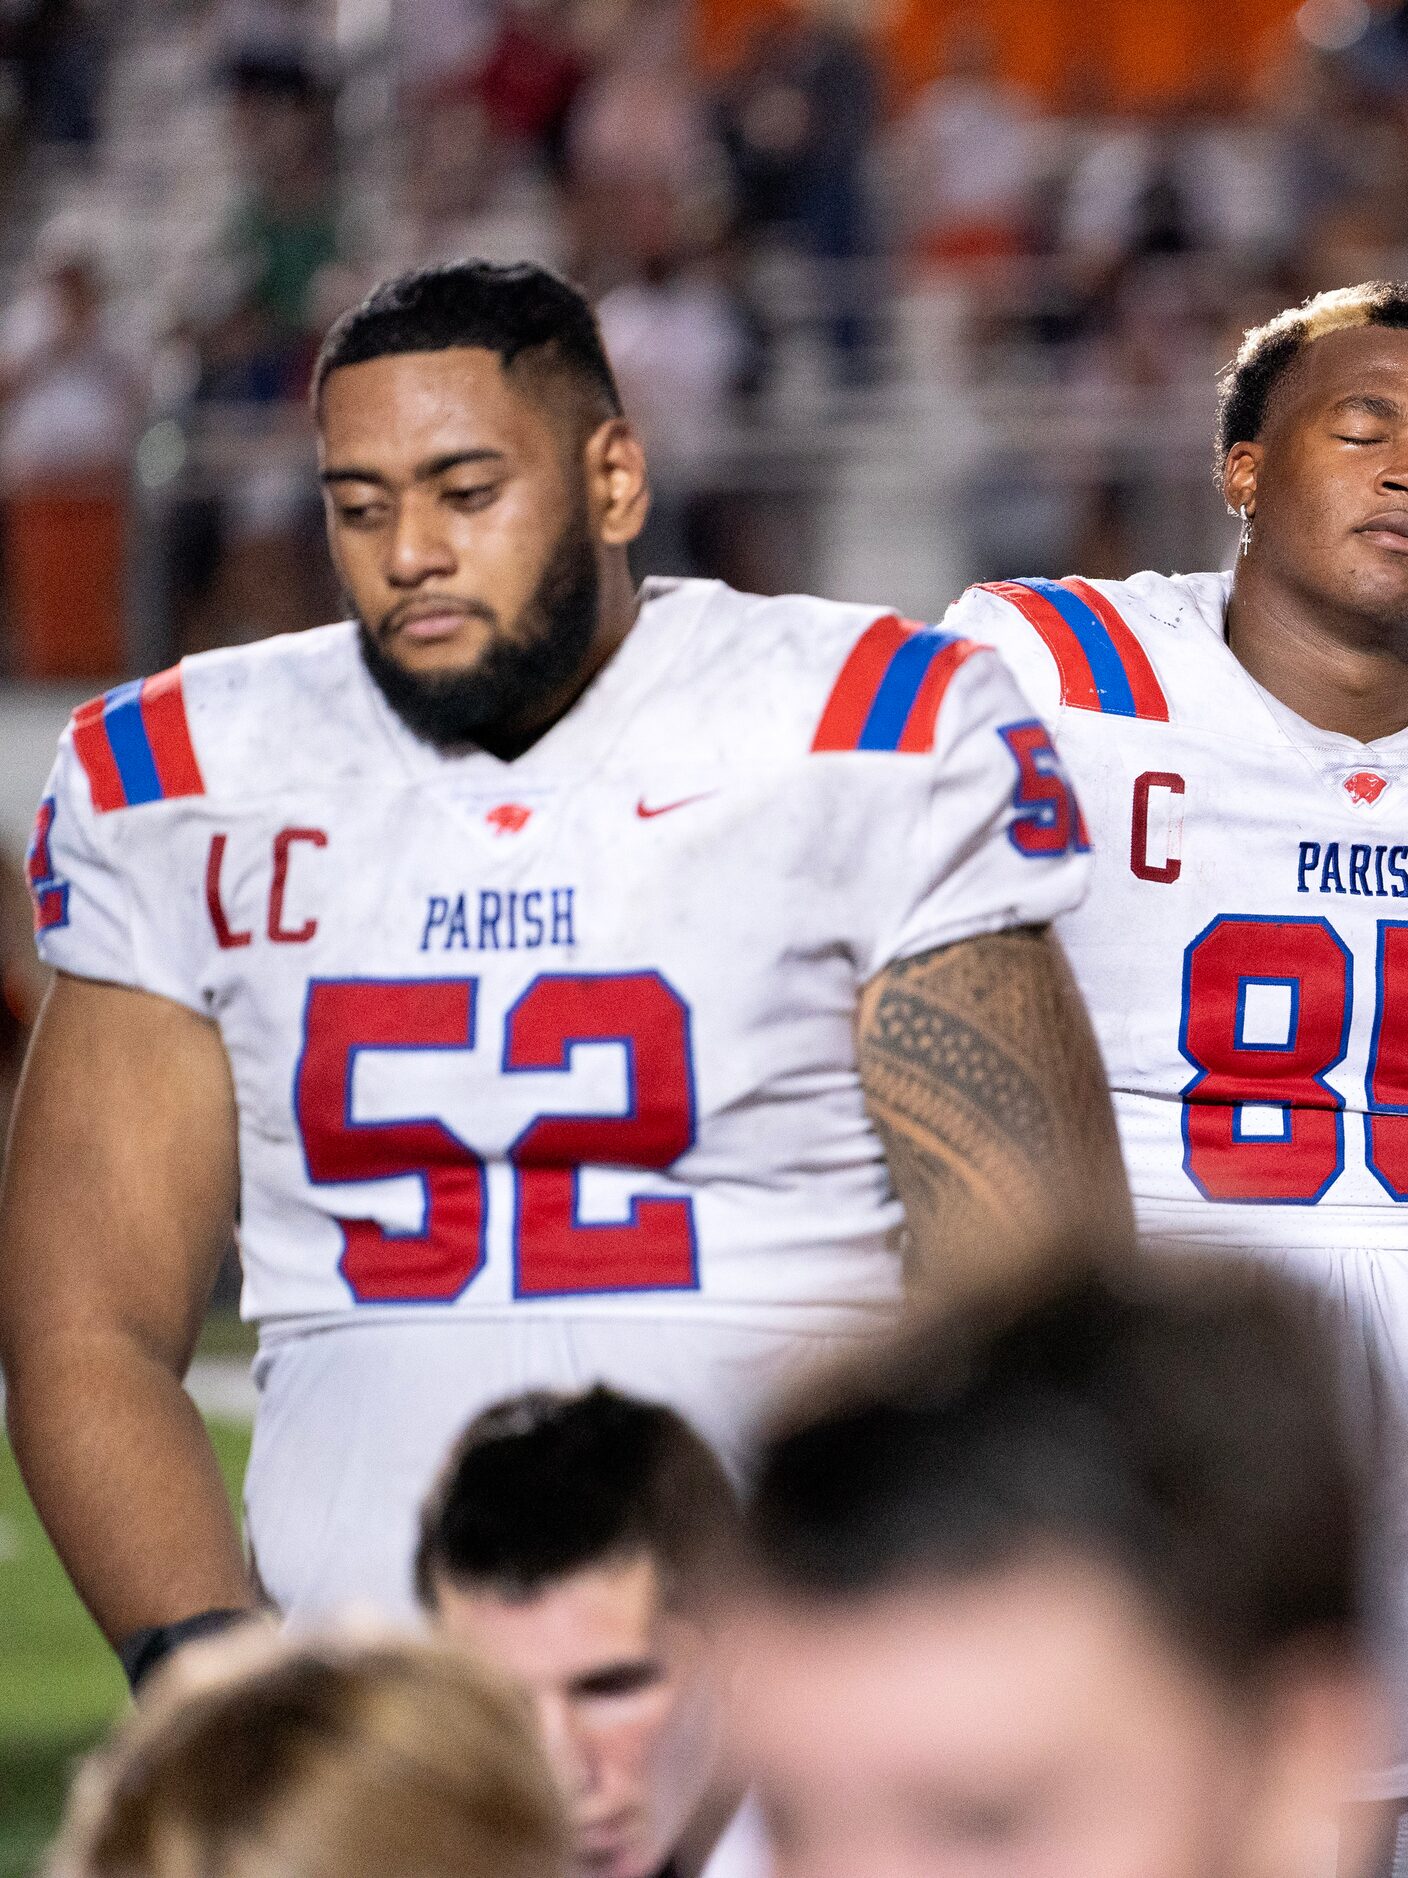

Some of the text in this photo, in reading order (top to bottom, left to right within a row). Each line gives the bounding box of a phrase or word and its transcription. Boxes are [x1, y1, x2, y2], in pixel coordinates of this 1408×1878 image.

[996, 718, 1091, 858] 5
[1131, 771, 1185, 884] C
[419, 886, 575, 951] PARISH
[294, 969, 700, 1304] 52
